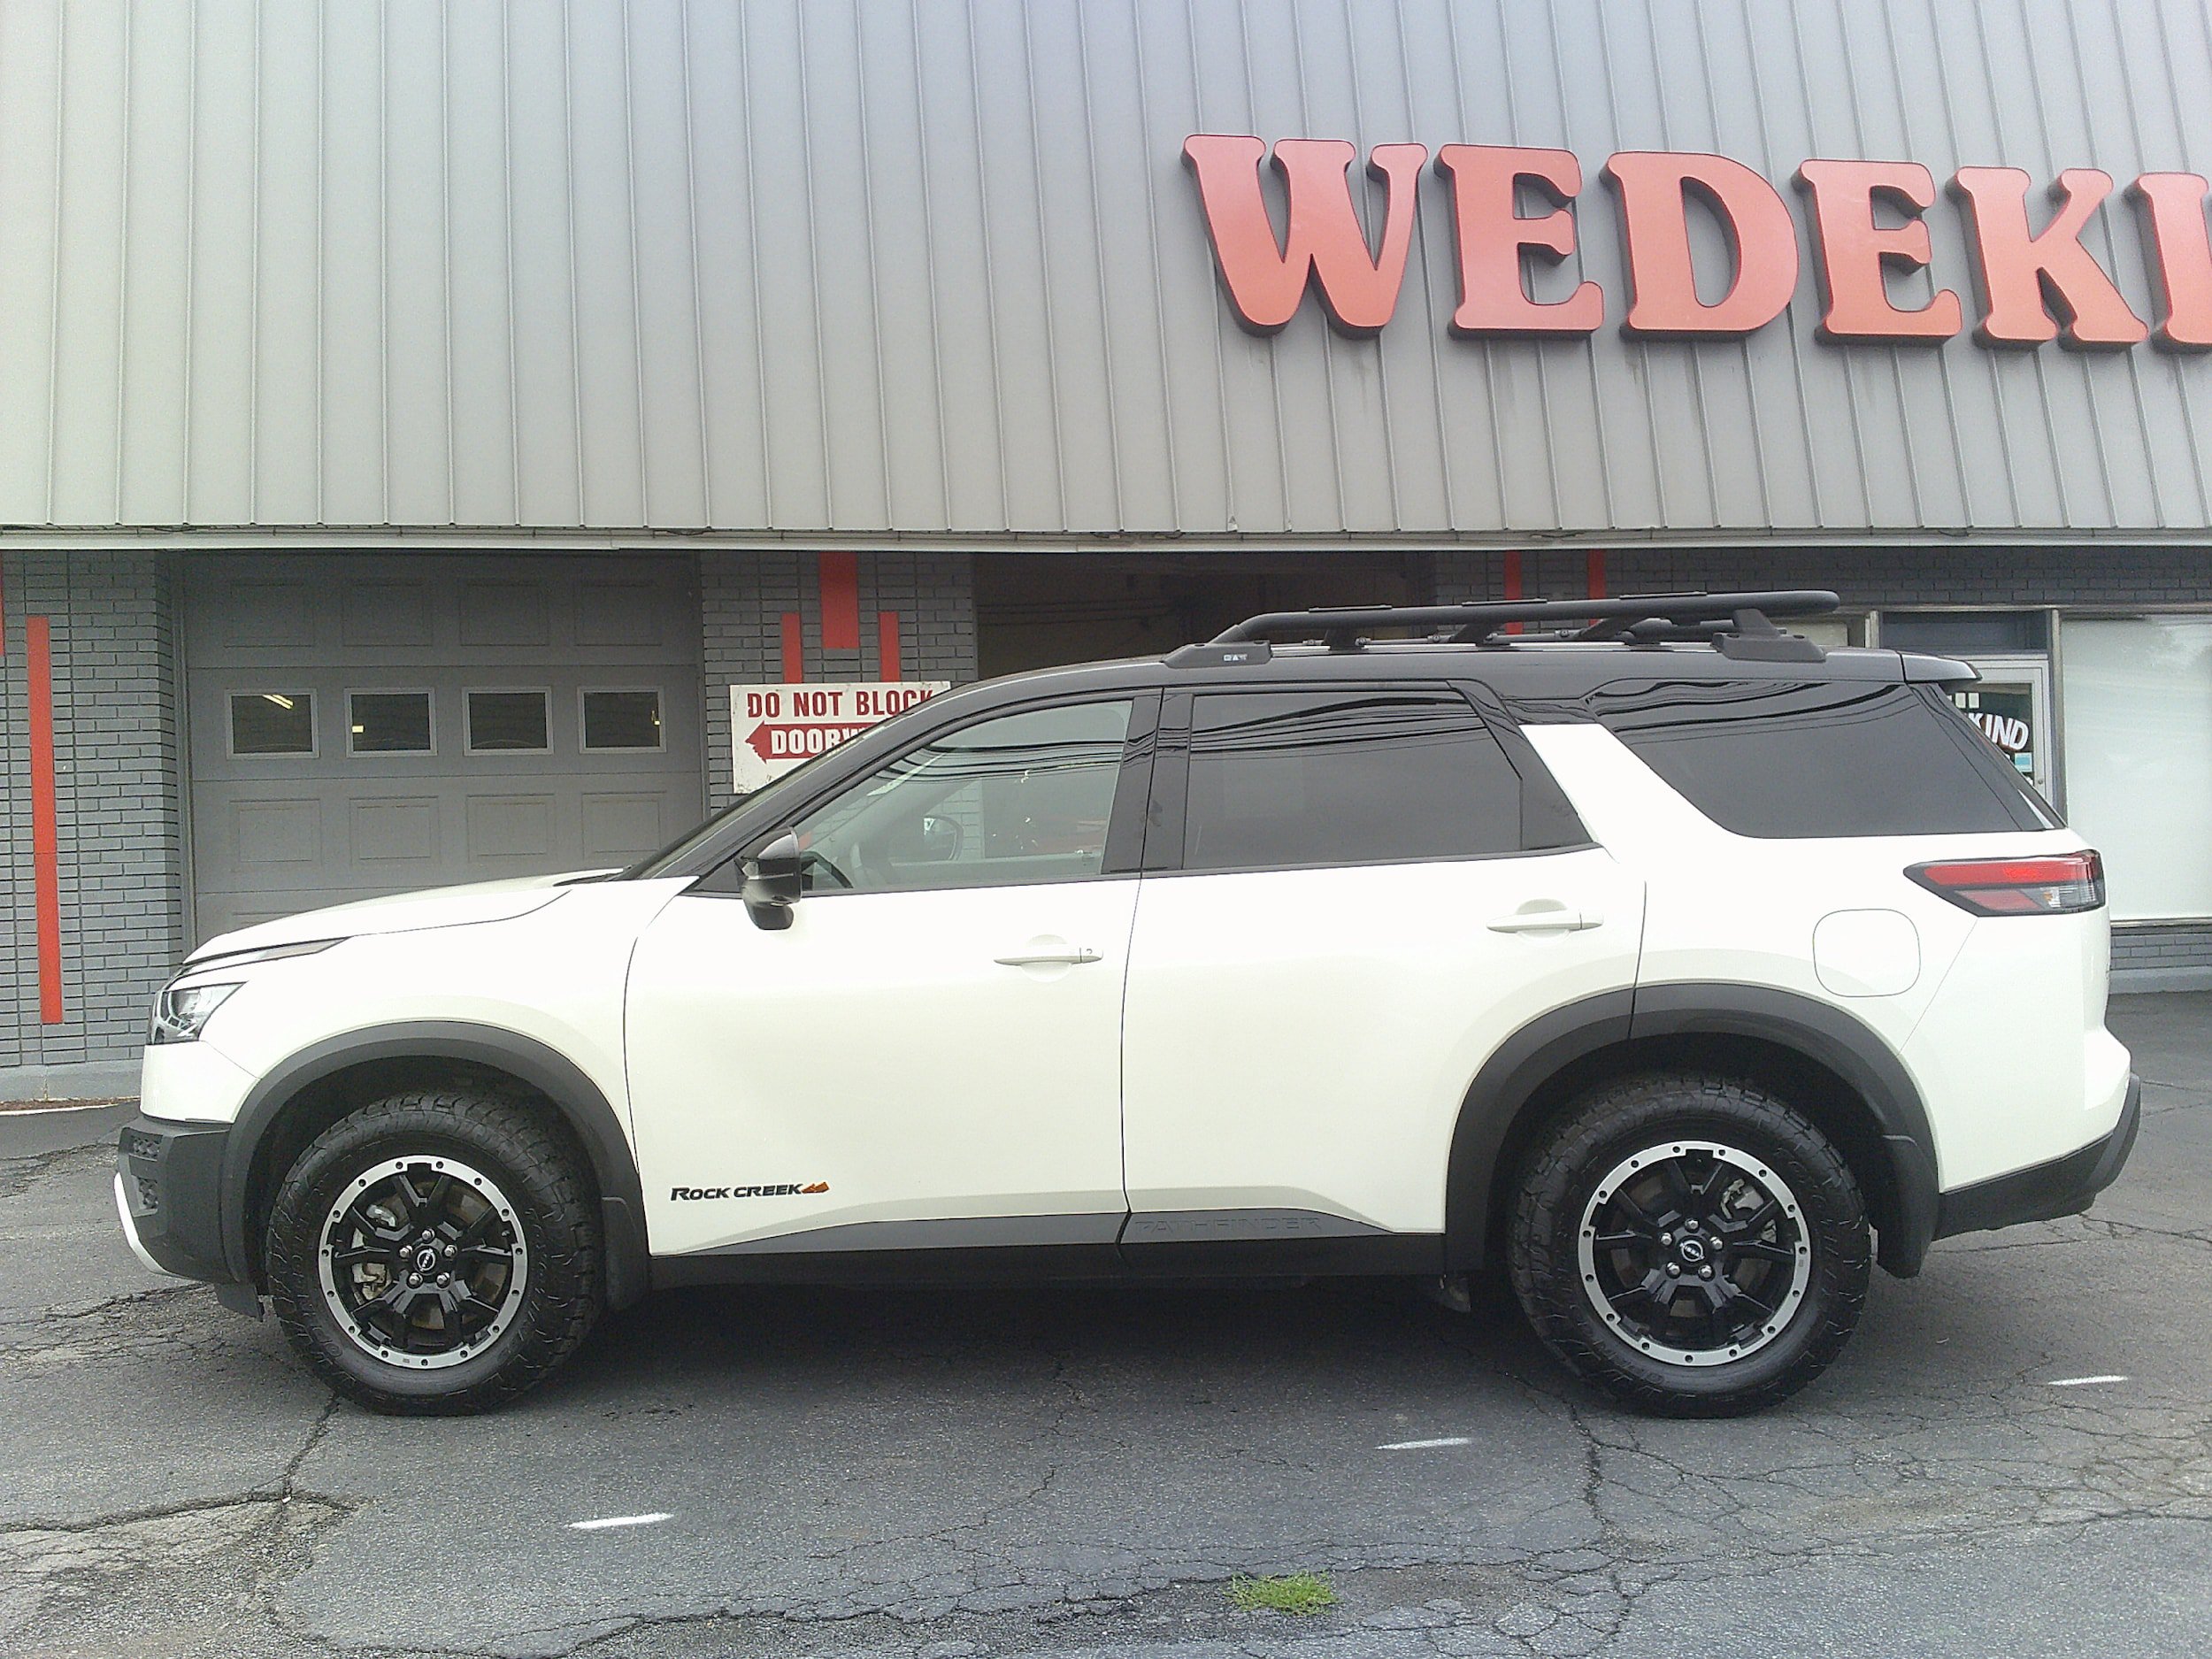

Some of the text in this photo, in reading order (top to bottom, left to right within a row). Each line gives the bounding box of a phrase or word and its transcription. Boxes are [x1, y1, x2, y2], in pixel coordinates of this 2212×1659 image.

[747, 692, 780, 718] DO
[793, 691, 843, 718] NOT
[670, 1183, 803, 1202] ROCK CREEK
[1135, 1217, 1323, 1234] PATHFINDER
